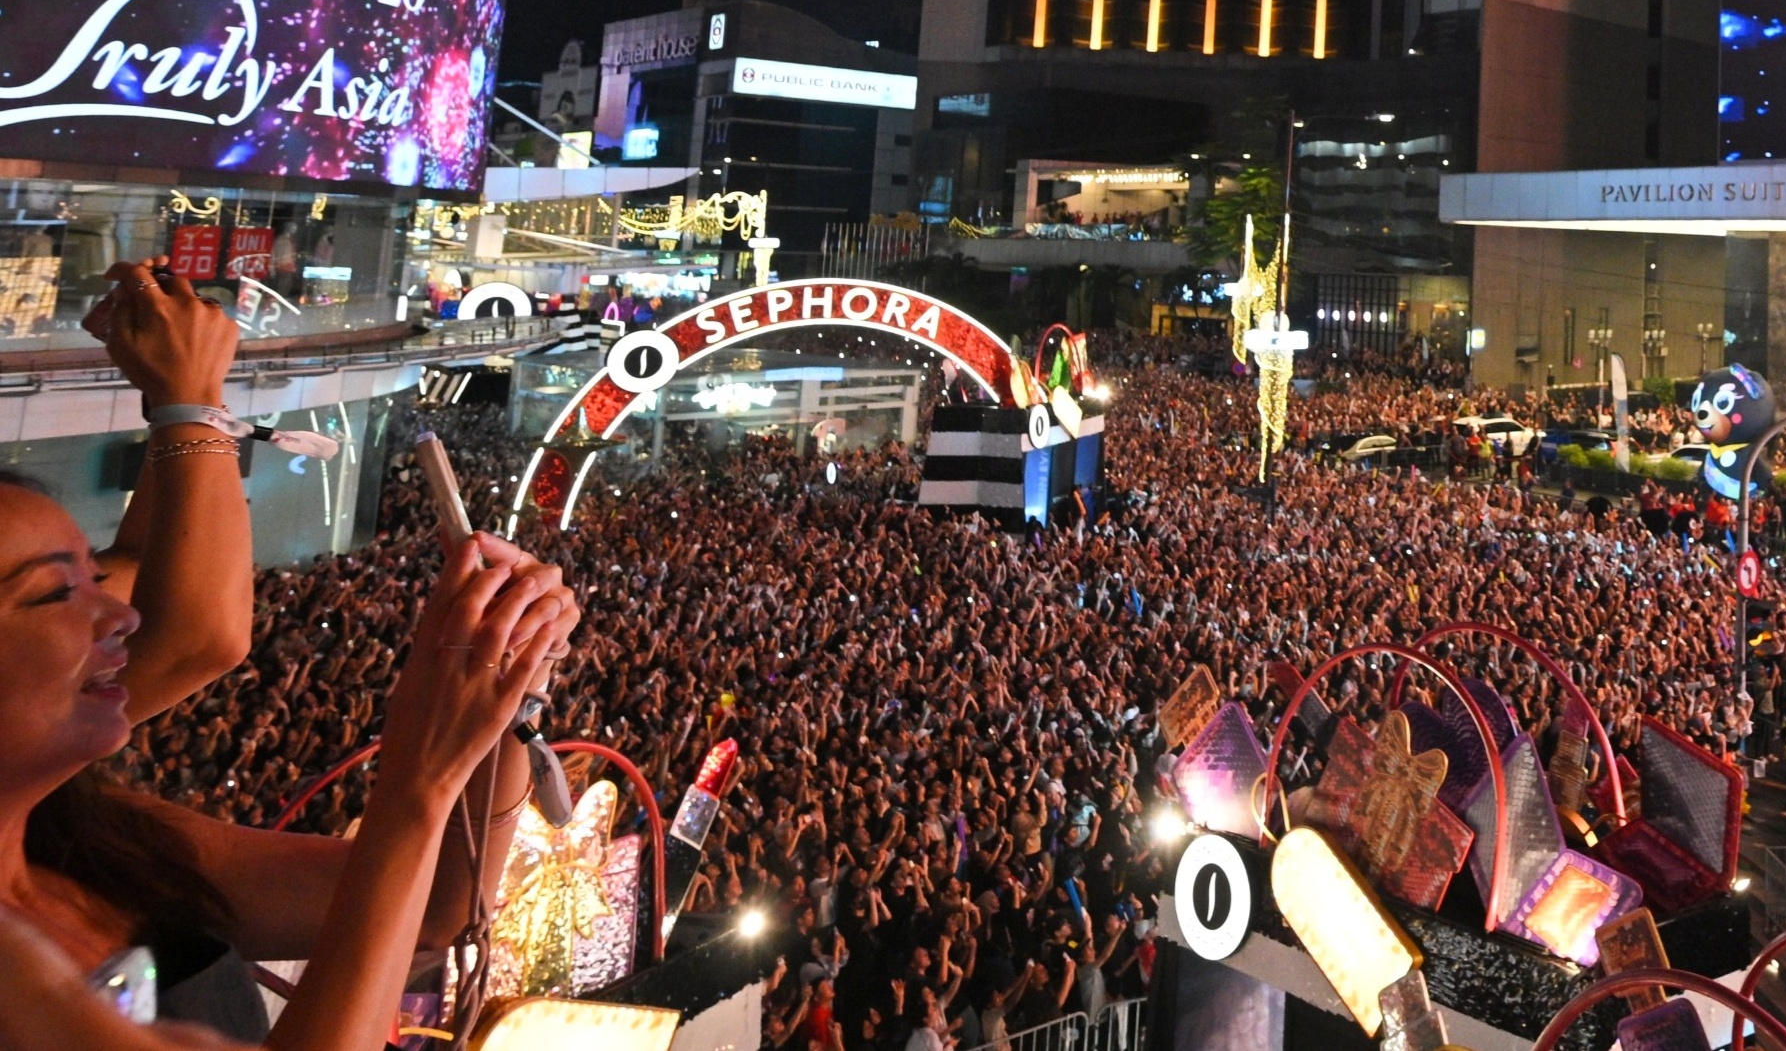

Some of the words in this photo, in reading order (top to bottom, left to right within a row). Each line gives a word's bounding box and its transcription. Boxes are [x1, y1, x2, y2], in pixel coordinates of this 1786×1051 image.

[282, 46, 413, 128] Asia
[761, 72, 824, 88] PUBLIC
[830, 79, 879, 93] BANK
[1601, 184, 1714, 204] PAVILION
[235, 233, 267, 251] UNI
[698, 287, 941, 344] SEPHORA
